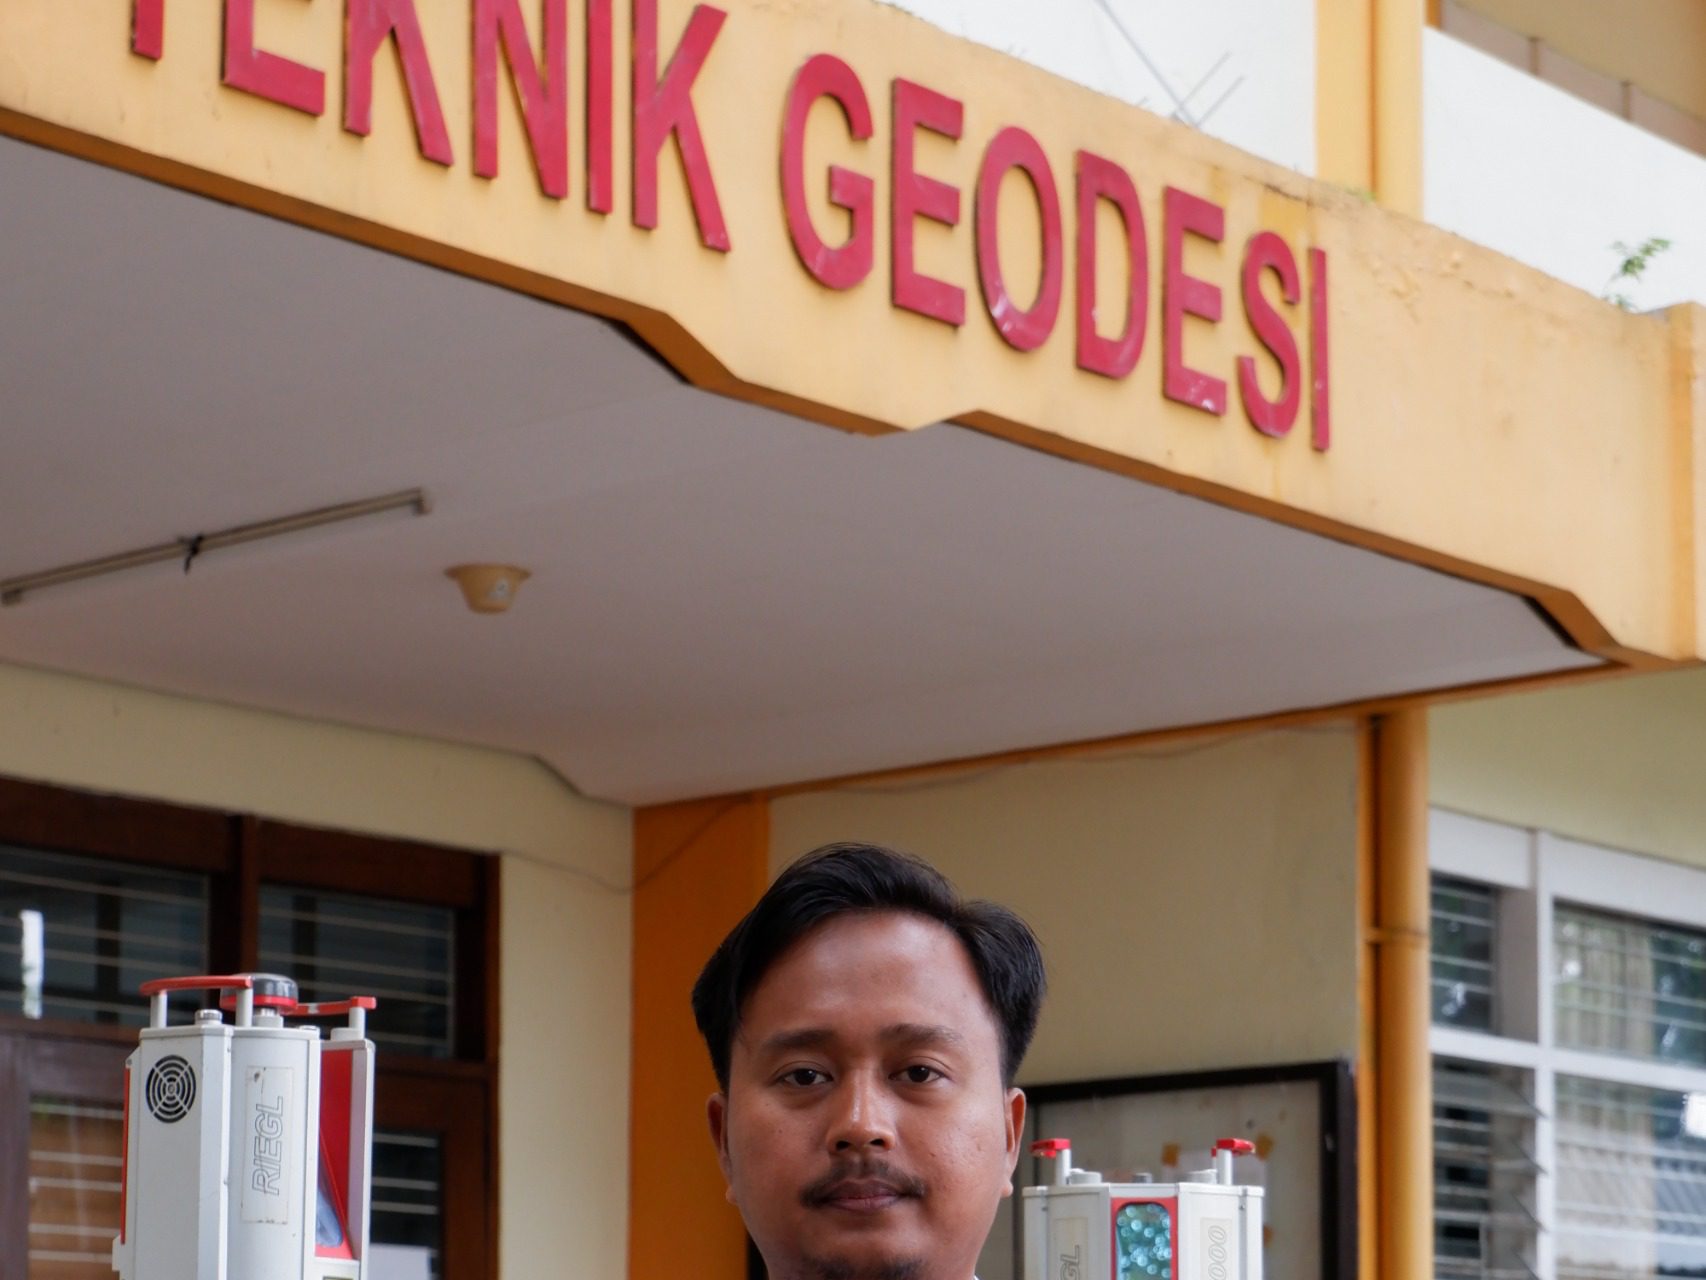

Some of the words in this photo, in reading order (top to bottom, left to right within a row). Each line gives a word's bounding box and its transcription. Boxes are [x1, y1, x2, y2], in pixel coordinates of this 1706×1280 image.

[131, 0, 731, 252] KNIK
[780, 53, 1329, 451] GEODESI
[252, 1095, 284, 1196] RIEGL
